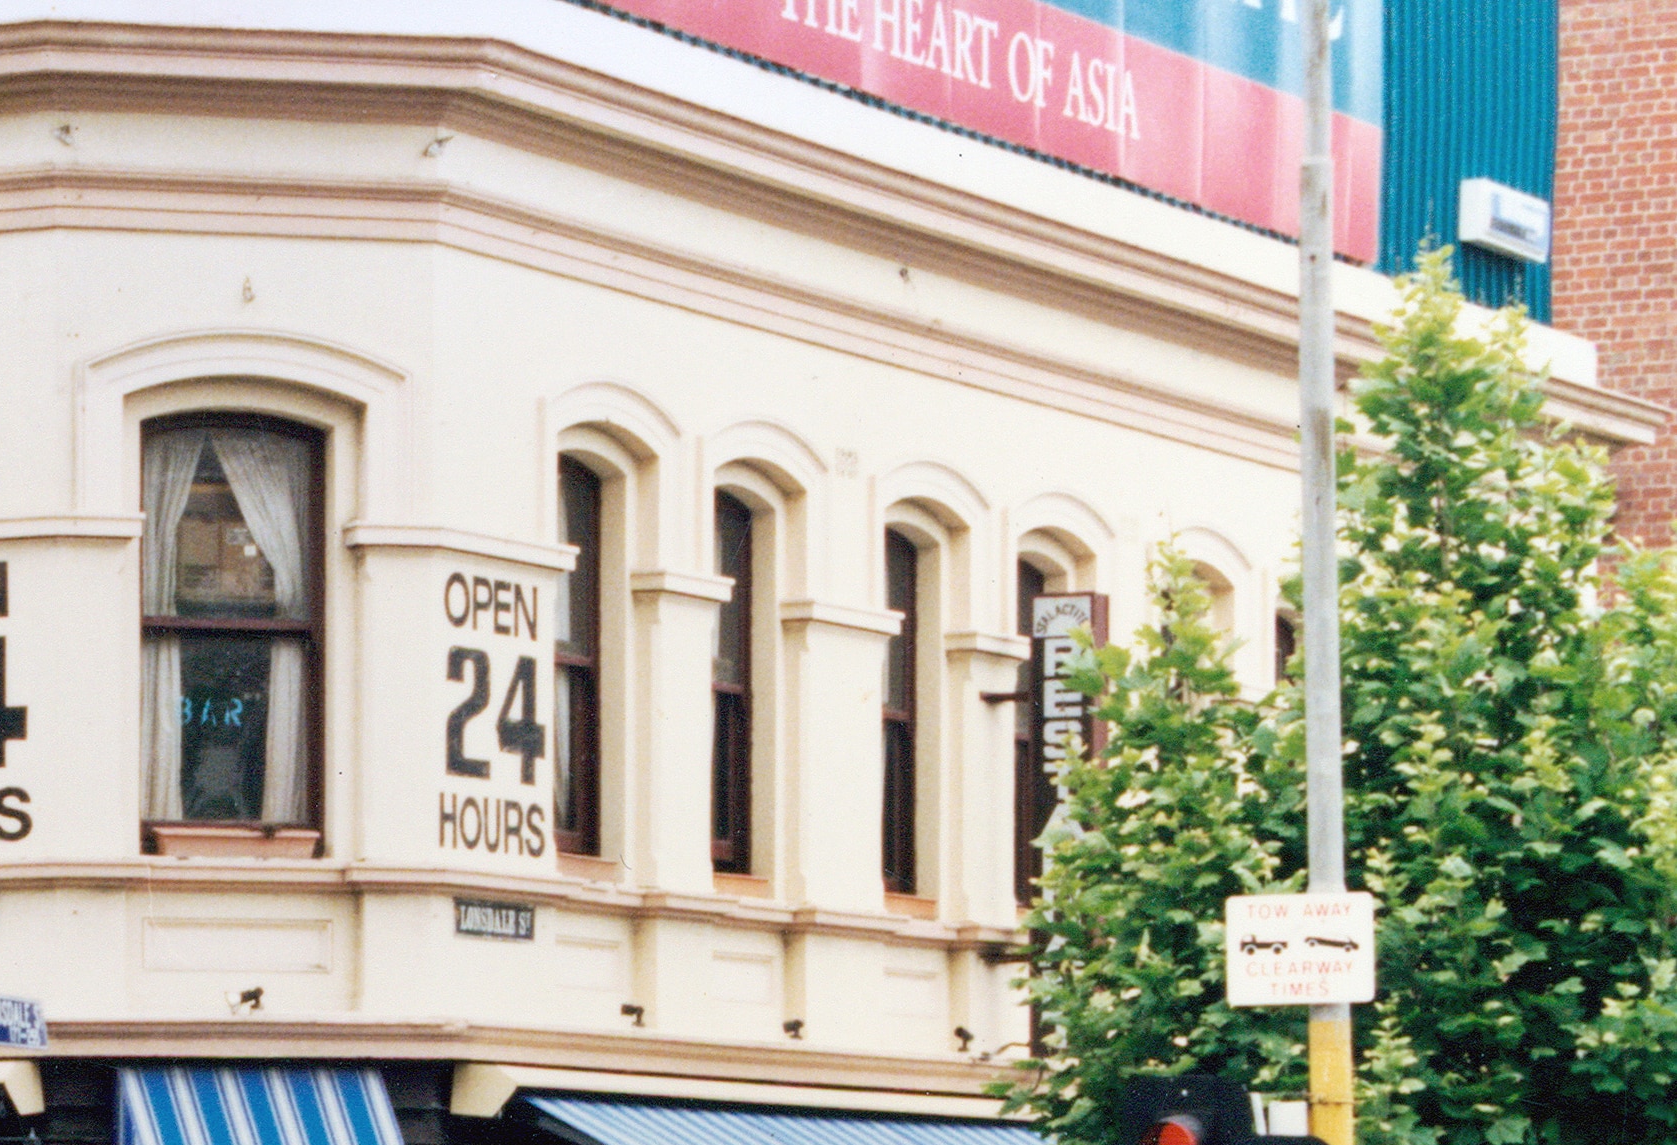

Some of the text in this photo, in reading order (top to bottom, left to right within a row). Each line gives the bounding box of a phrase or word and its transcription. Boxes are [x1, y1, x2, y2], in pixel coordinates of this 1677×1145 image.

[873, 0, 999, 89] HEART
[1007, 31, 1054, 108] OF
[1063, 51, 1141, 140] ASIA
[444, 572, 538, 641] OPEN
[445, 645, 546, 786] 24
[438, 792, 545, 858] HOURS
[459, 905, 516, 935] LONSDALE
[1247, 902, 1351, 919] TOW AWAY
[1246, 960, 1353, 977] CLEARWAY
[1271, 981, 1330, 997] TIMES
